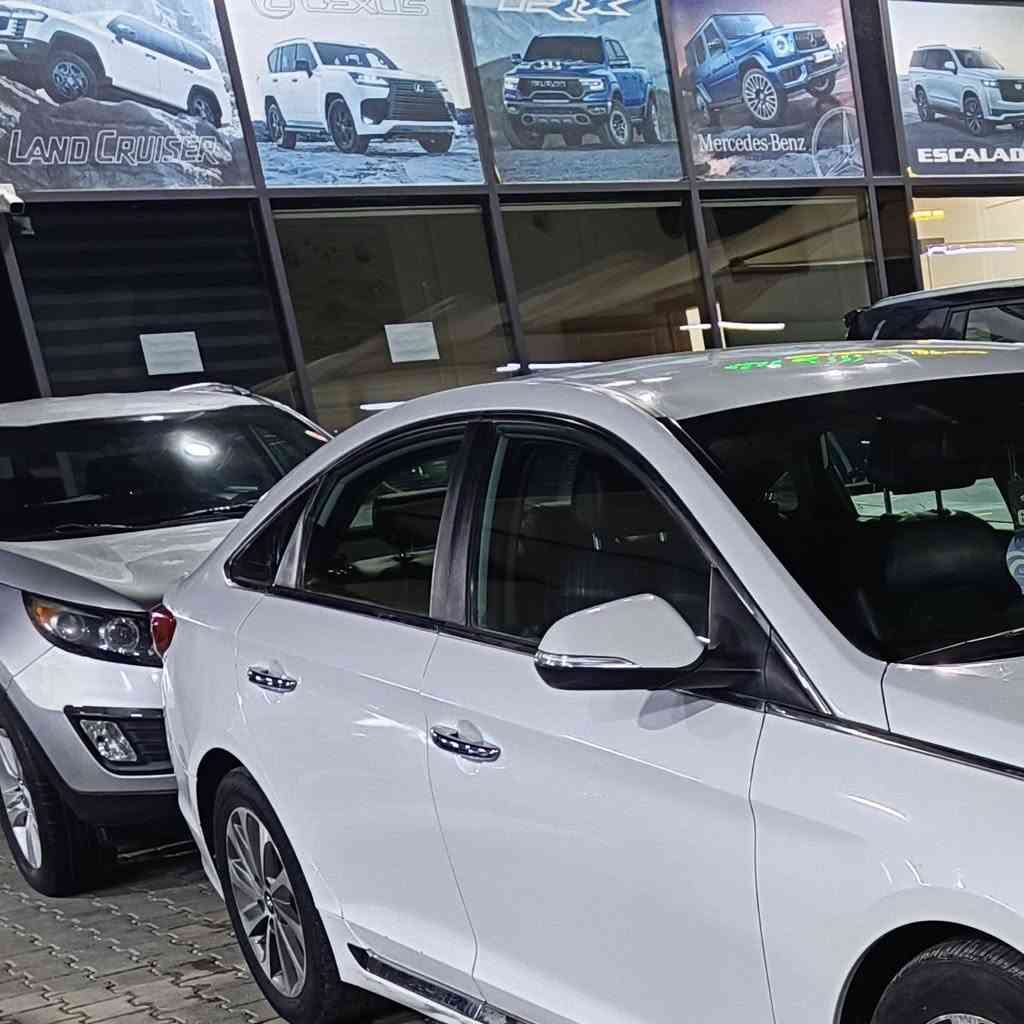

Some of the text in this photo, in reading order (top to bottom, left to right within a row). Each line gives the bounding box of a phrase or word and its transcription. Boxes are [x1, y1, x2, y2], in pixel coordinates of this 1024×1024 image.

[8, 129, 220, 166] LAND CRUISER
[698, 132, 807, 152] Mercedes-Benz
